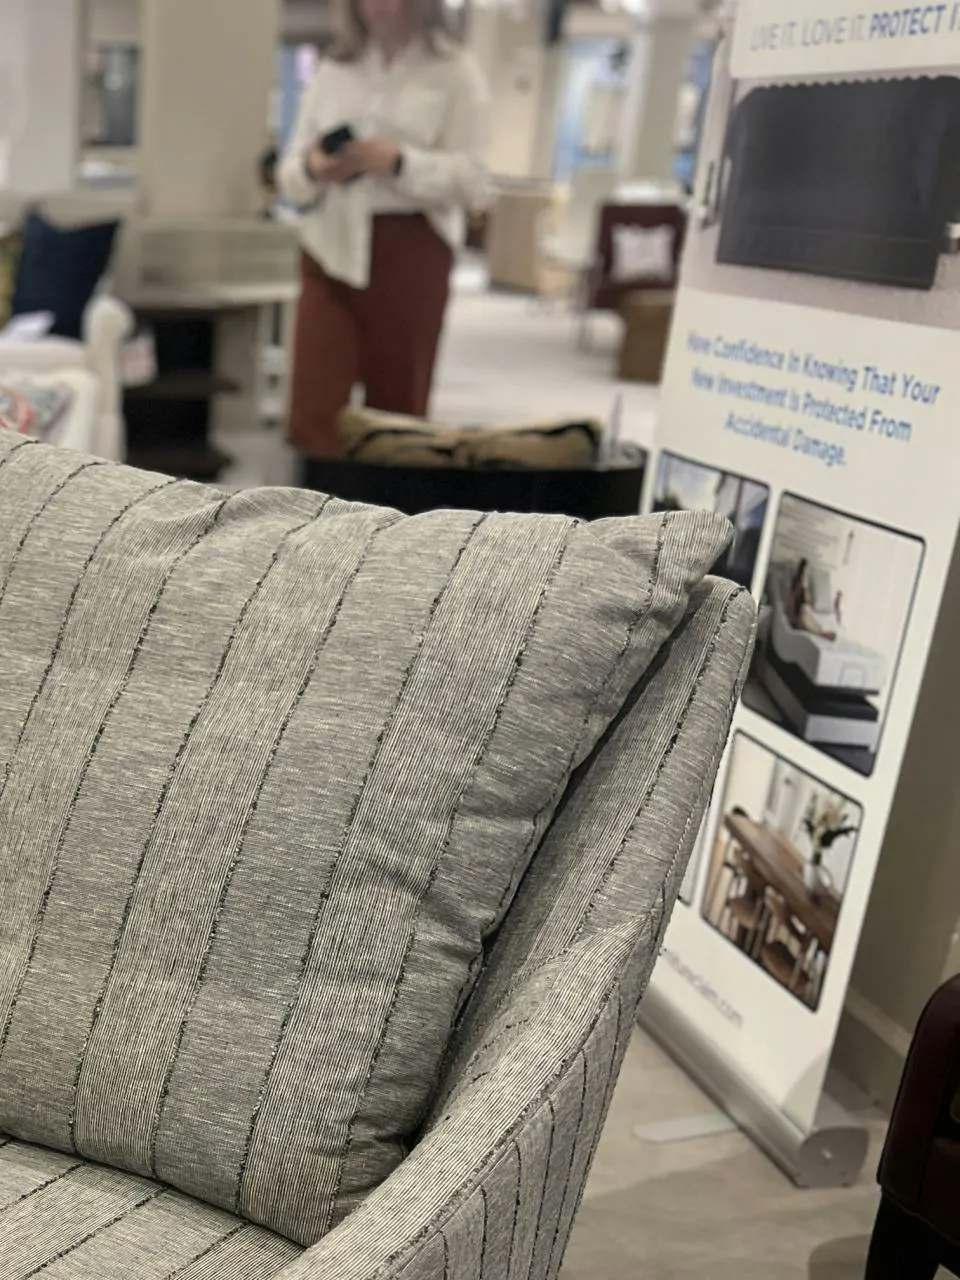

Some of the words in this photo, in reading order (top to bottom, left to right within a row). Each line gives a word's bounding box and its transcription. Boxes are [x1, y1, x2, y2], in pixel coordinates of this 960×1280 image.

[801, 17, 847, 46] LOVE
[868, 5, 946, 40] PROTECT
[949, 0, 960, 31] I
[714, 337, 784, 370] Confidence
[804, 354, 857, 391] Knowing
[863, 367, 895, 395] That
[902, 375, 940, 404] Your
[719, 375, 786, 408] Investment
[804, 394, 865, 430] Protected
[869, 411, 911, 442] From
[725, 413, 790, 446] Accidental
[794, 430, 846, 466] Damage.
